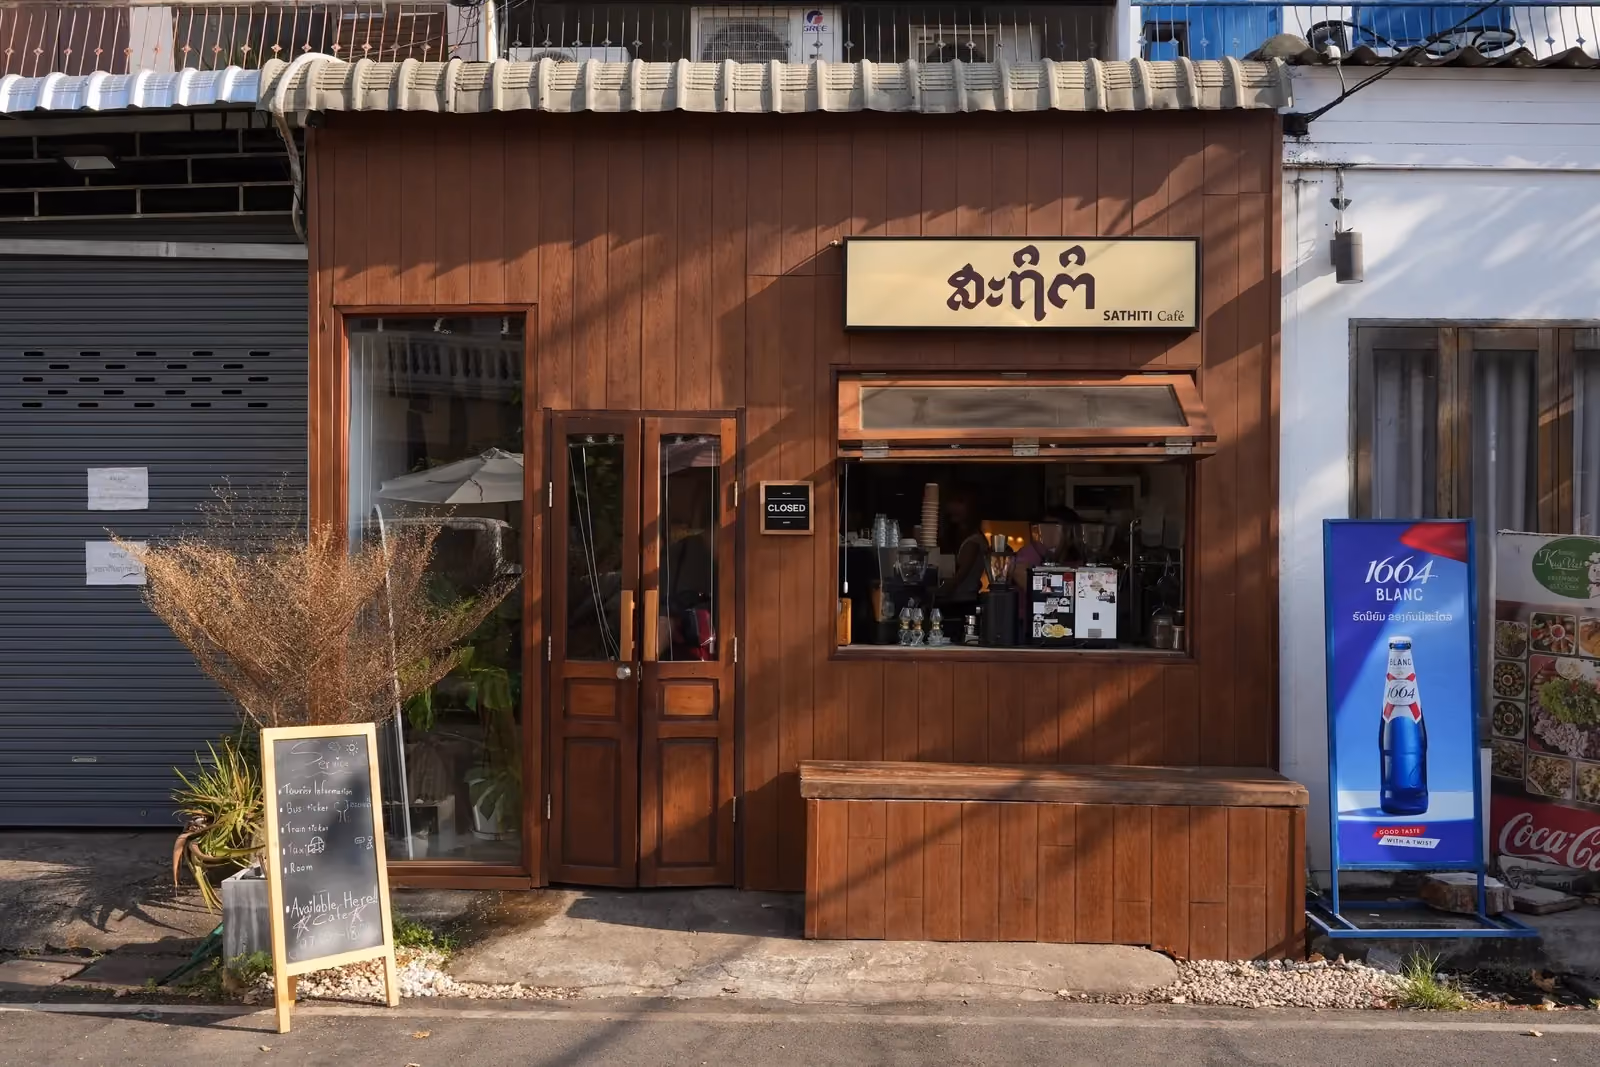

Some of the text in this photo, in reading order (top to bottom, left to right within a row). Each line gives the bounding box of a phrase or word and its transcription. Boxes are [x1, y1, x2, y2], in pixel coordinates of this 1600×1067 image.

[1103, 310, 1185, 322] SATHITI Café
[768, 504, 805, 512] CLOSED
[1365, 556, 1438, 584] 1664
[1376, 588, 1424, 601] BLANC
[1389, 658, 1412, 666] BLANC
[1387, 685, 1416, 699] 1664
[290, 740, 349, 770] Service
[314, 780, 353, 796] Information
[286, 801, 303, 814] Bus
[285, 820, 306, 834] Train
[290, 862, 314, 874] Room
[290, 893, 338, 918] Available
